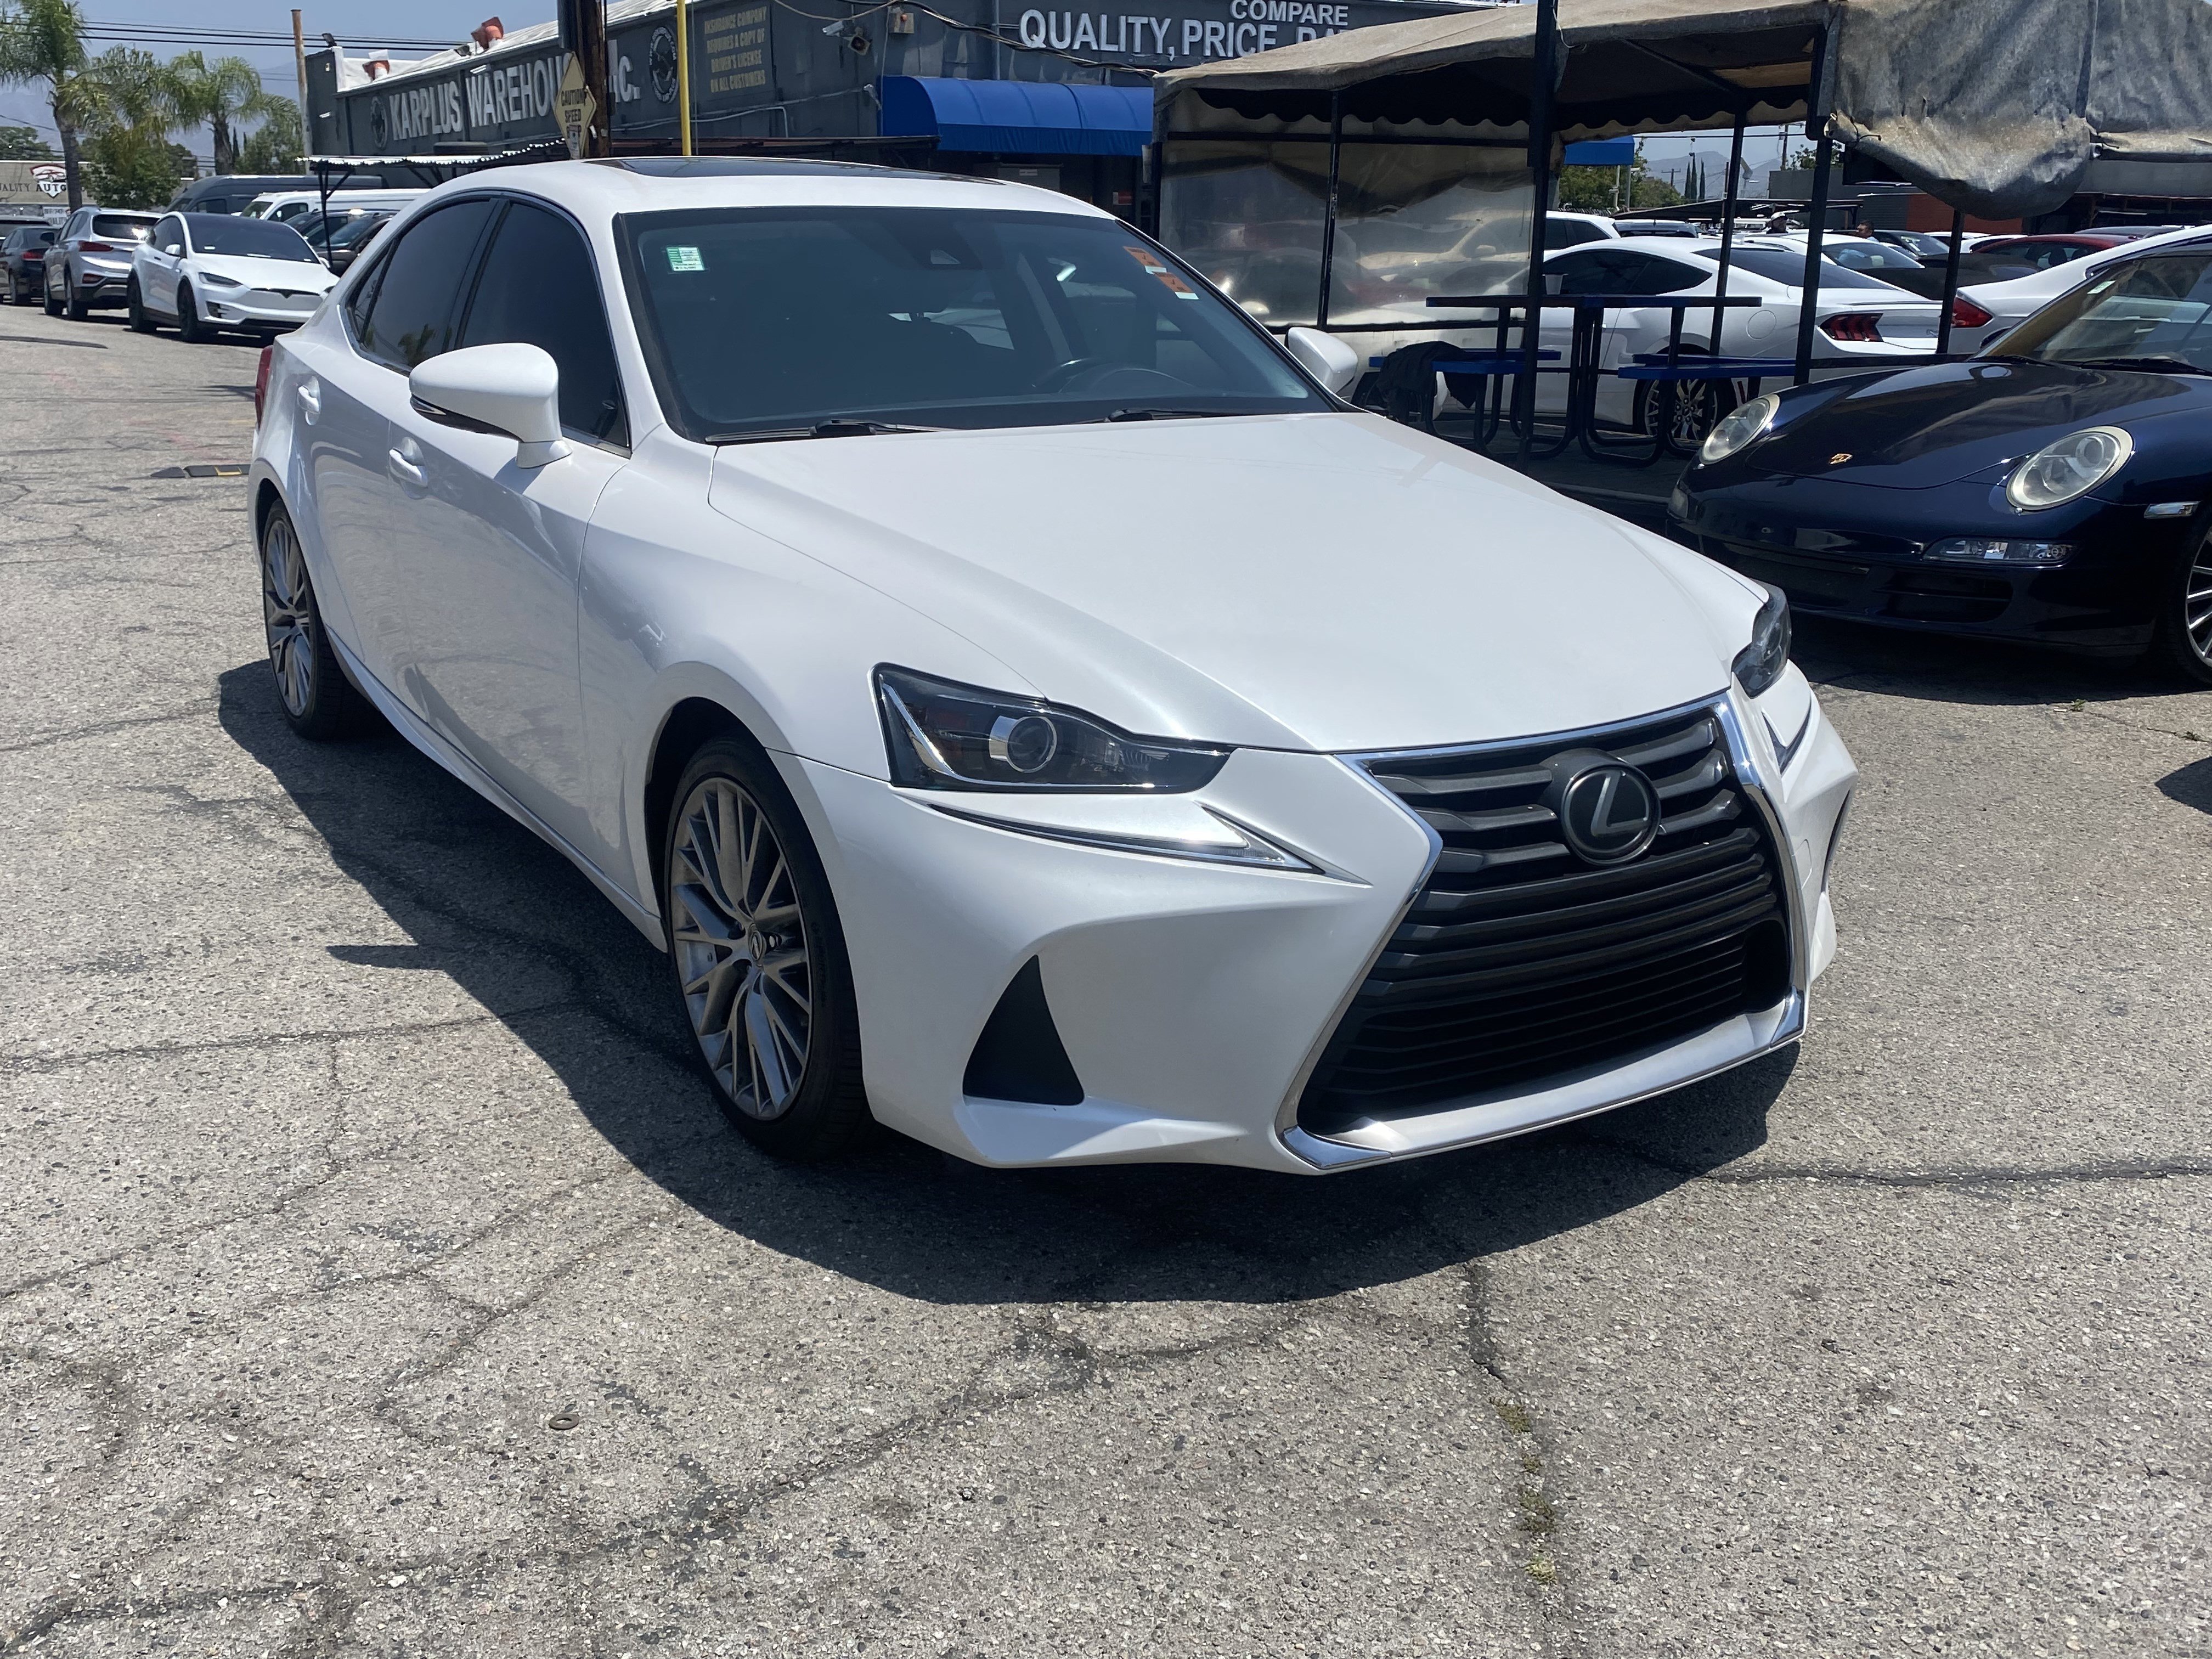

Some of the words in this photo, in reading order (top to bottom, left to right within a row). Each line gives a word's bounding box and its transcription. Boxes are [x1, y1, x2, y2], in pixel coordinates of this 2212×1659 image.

[1230, 0, 1348, 26] COMPARE
[1019, 9, 1176, 61] QUALITY,
[389, 81, 462, 140] KARPLUS
[465, 52, 573, 127] WAREHOU
[0, 183, 30, 192] ALITY
